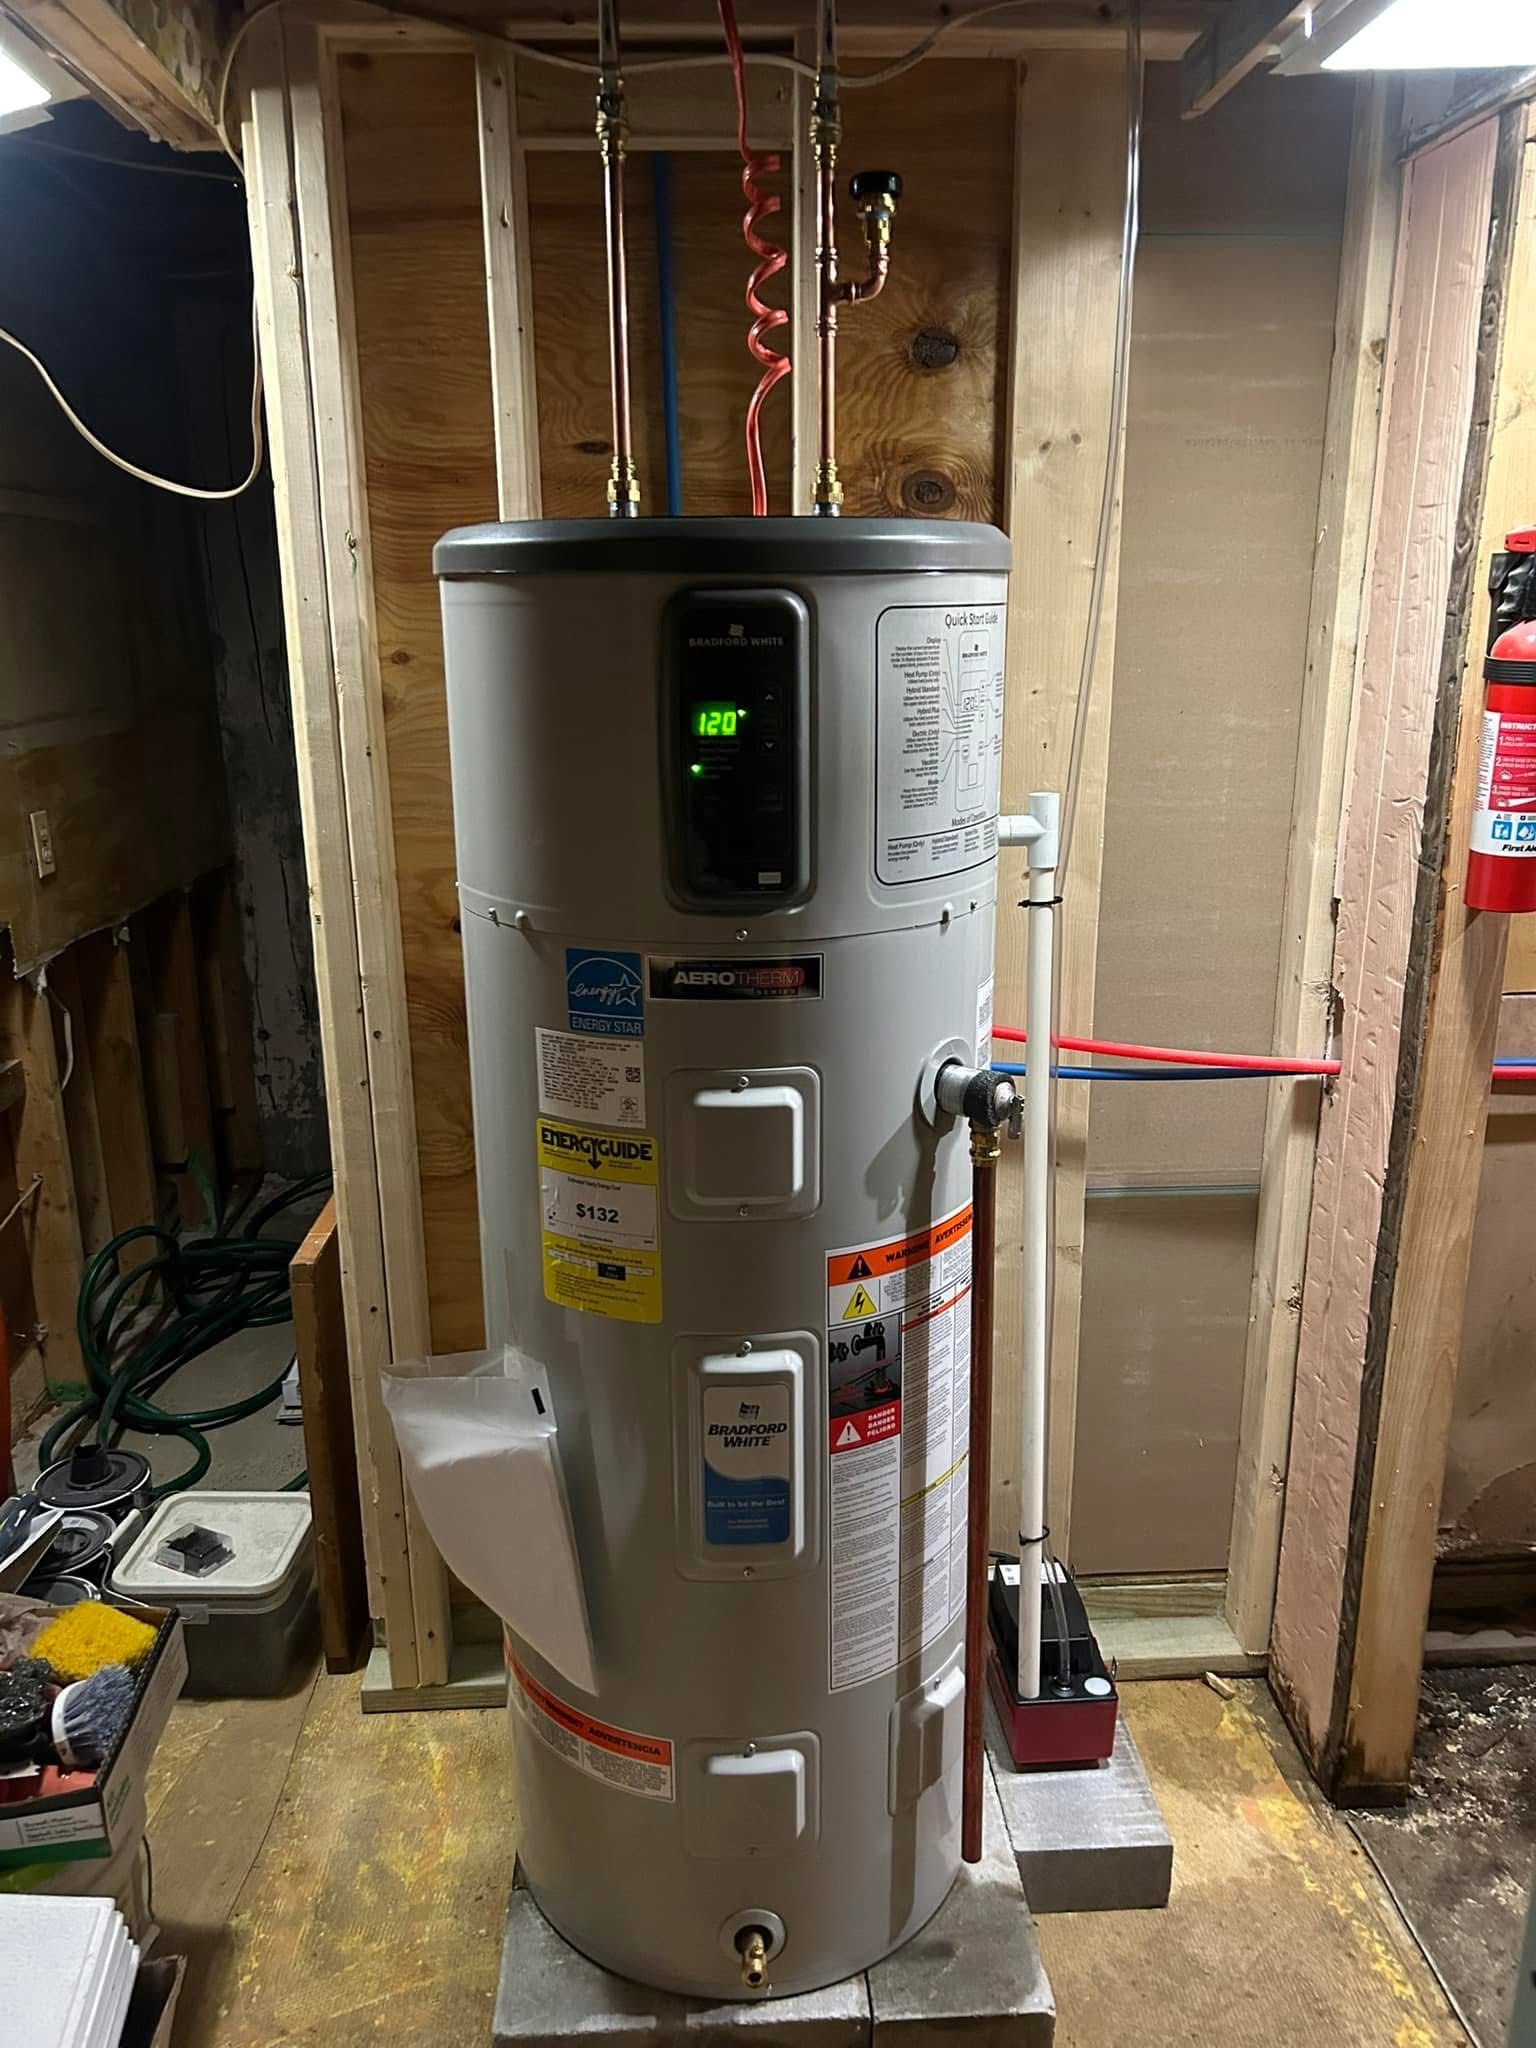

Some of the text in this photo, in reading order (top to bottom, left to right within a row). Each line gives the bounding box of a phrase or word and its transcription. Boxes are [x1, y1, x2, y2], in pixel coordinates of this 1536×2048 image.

[945, 612, 967, 628] Quick
[969, 612, 984, 625] Start
[688, 636, 784, 647] BRADFORD WHITE
[699, 711, 737, 736] 120
[1499, 735, 1504, 746] 1
[1495, 756, 1502, 767] 2
[1492, 784, 1498, 795] 3
[888, 843, 899, 851] Heat
[900, 842, 912, 850] Pump
[1502, 844, 1523, 852] First
[673, 969, 800, 985] AEROTHERM
[572, 1016, 641, 1034] ENERGY STAR
[576, 1203, 619, 1223] $132
[885, 1240, 930, 1264] WARNING
[867, 1407, 896, 1421] DANGER
[867, 1415, 896, 1429] DANGER
[707, 1423, 787, 1436] BRADFORD
[867, 1423, 896, 1437] PELIGRO
[723, 1436, 771, 1448] WHITE
[588, 1726, 661, 1756] ADVERTENCIA
